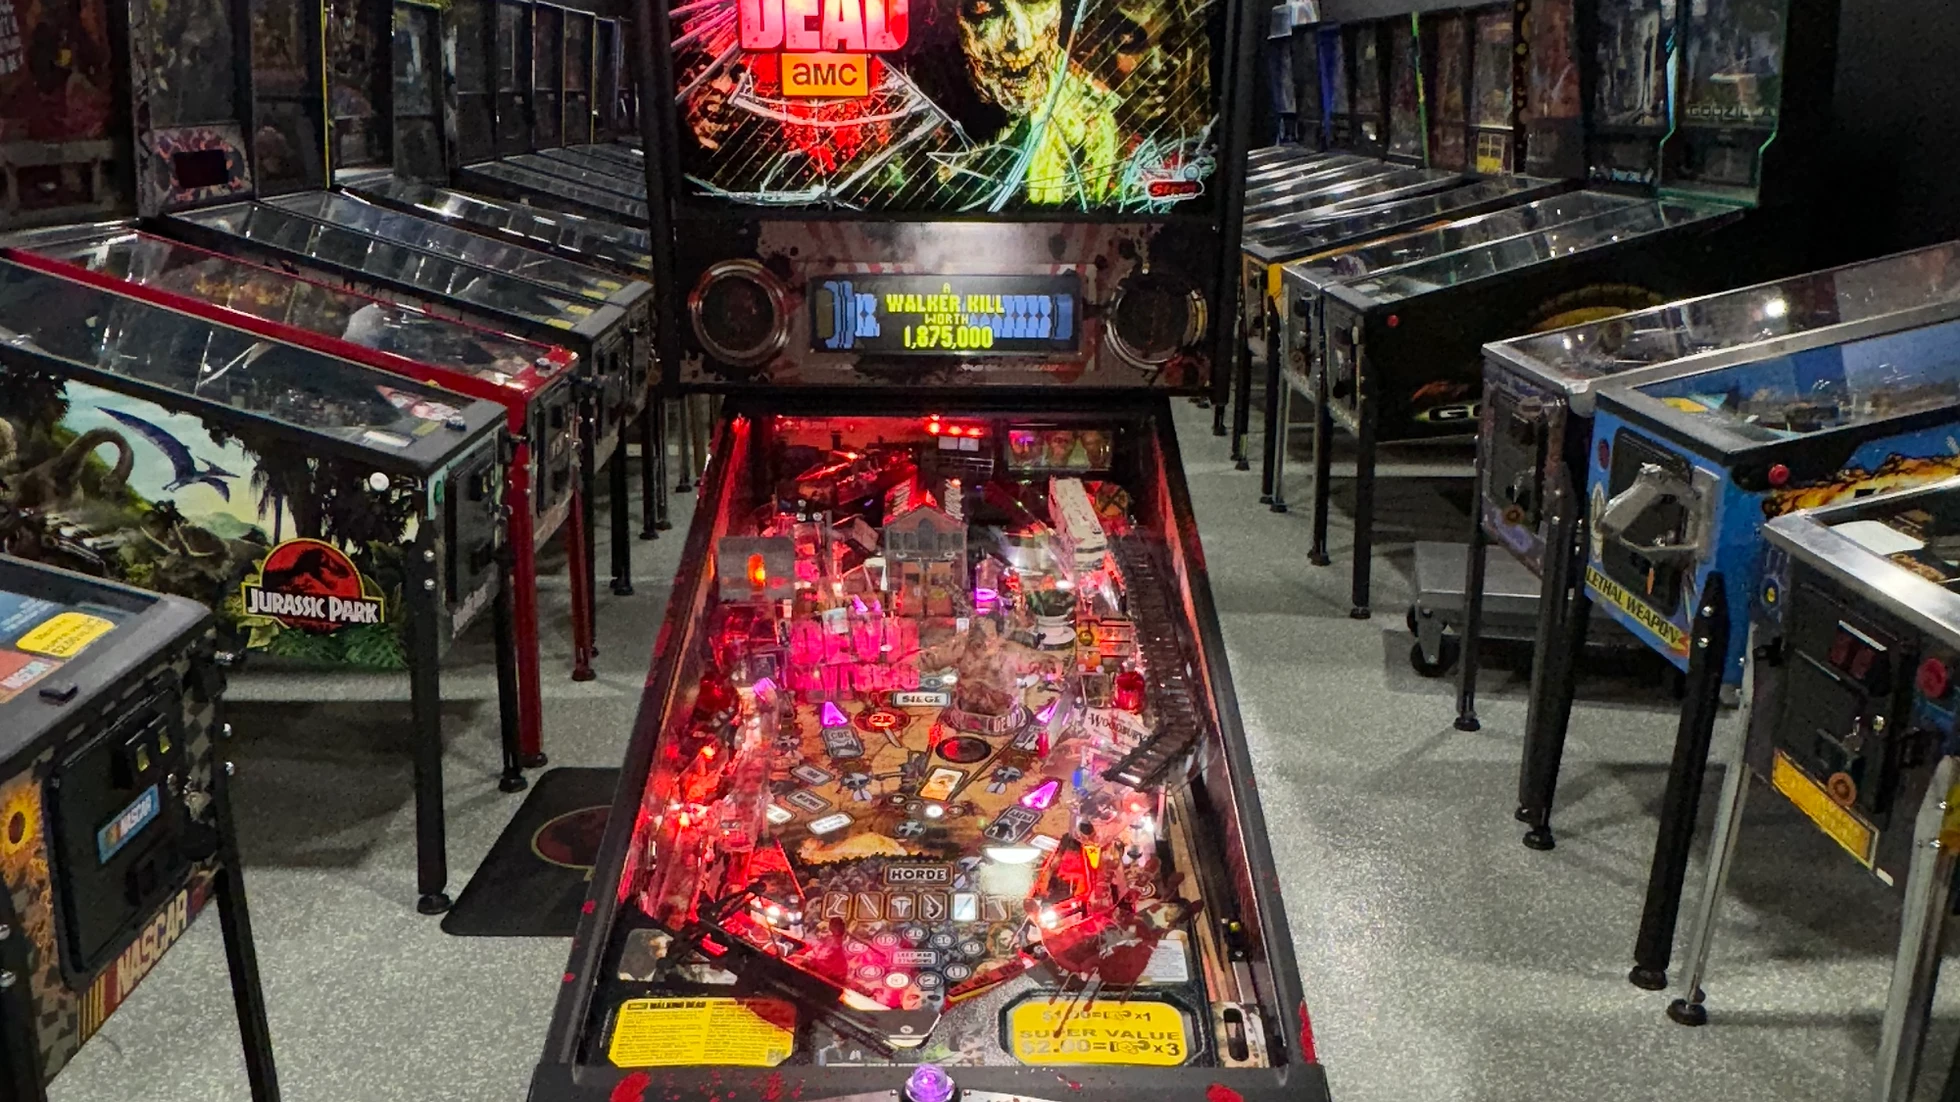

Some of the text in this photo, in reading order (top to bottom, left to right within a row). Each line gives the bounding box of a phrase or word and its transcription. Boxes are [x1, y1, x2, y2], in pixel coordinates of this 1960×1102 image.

[739, 0, 909, 50] DEAD
[943, 282, 950, 293] A
[886, 294, 1005, 313] WALKER KILL
[925, 313, 969, 325] WORTH
[904, 325, 993, 350] 1,875,000
[247, 588, 379, 623] JURASSIC PARK
[1586, 567, 1679, 644] LETHAL WEAPON
[902, 694, 941, 704] SIEGE
[891, 869, 947, 881] HORDE
[117, 889, 188, 1003] NASCAR
[1019, 1028, 1180, 1040] SUER VALUE
